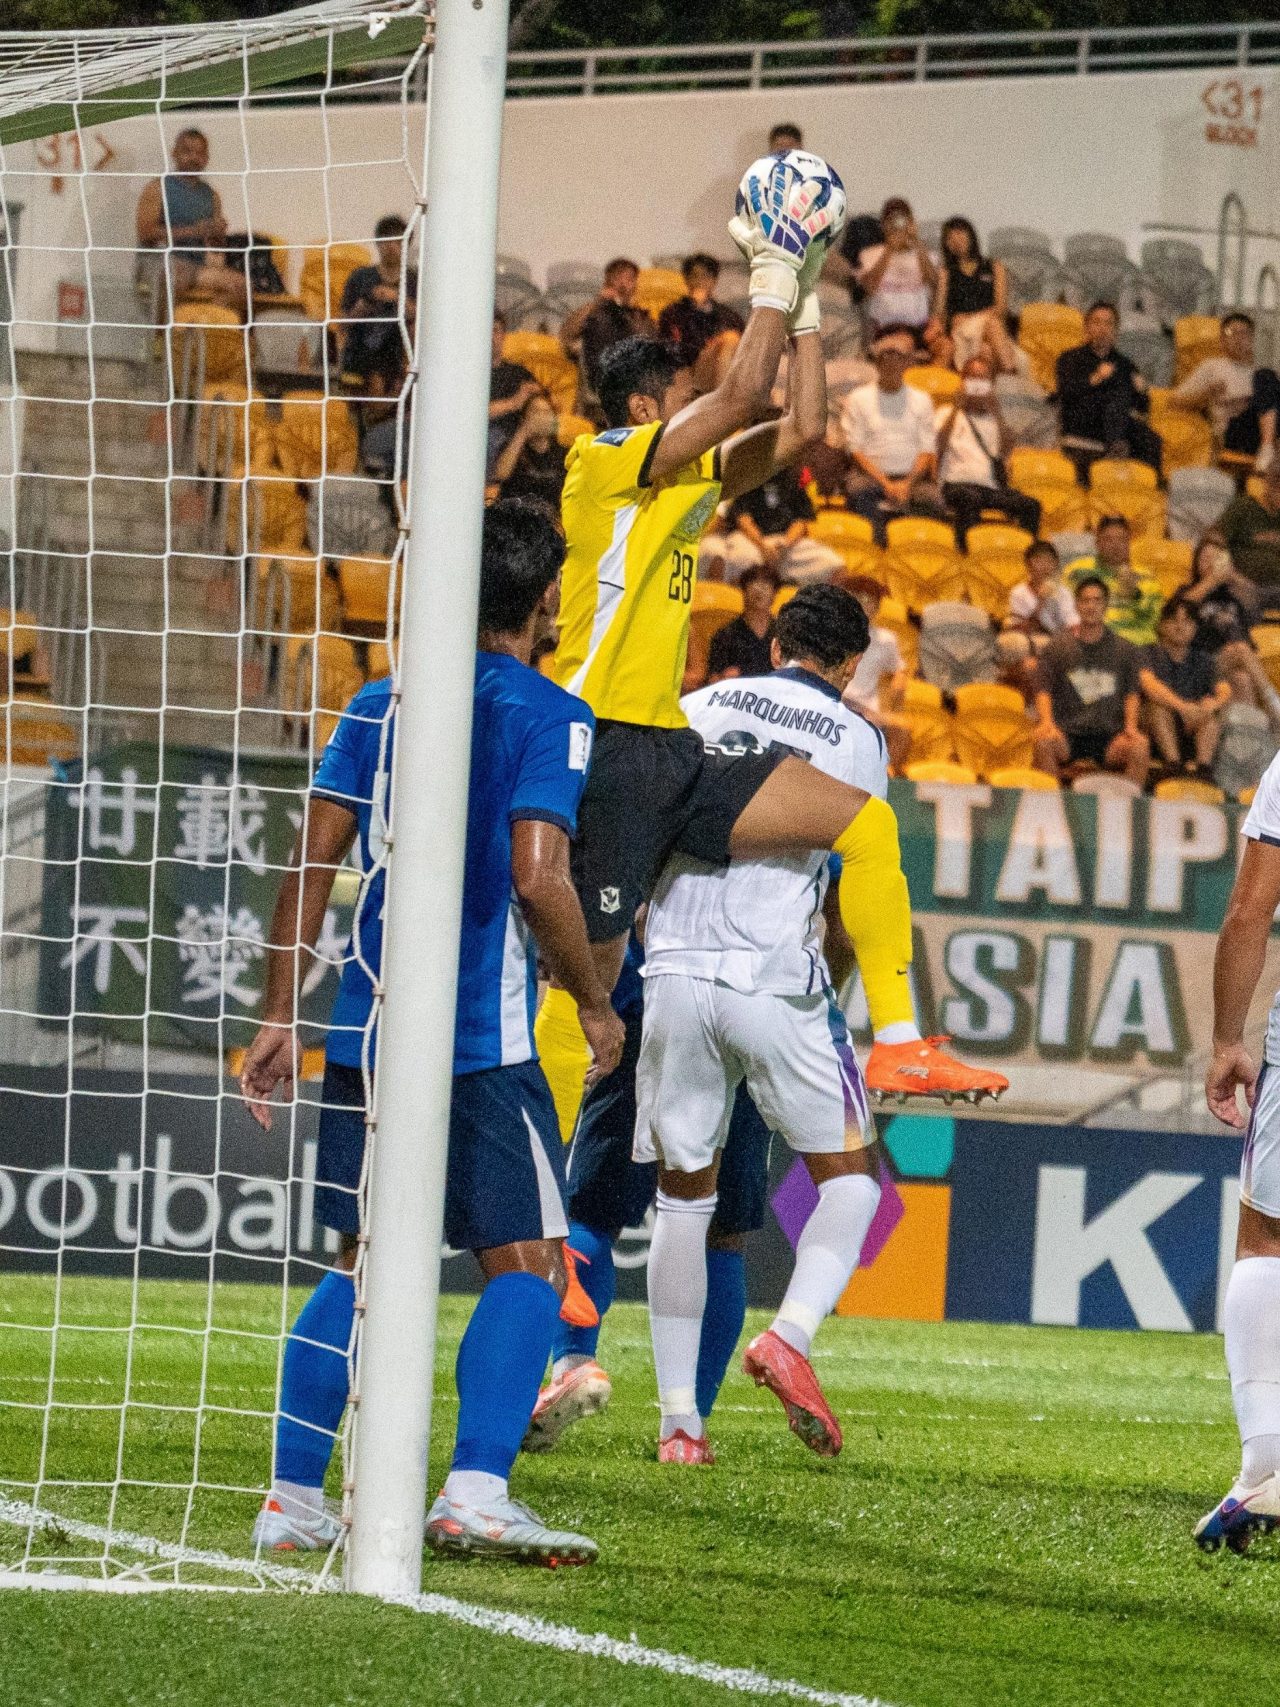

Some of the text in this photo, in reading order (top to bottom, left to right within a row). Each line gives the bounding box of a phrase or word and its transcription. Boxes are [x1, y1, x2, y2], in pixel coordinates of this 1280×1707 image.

[668, 549, 694, 604] 28
[707, 689, 847, 747] MARQUINHOS
[67, 765, 302, 876] 廿載
[916, 782, 1240, 914] TAIP
